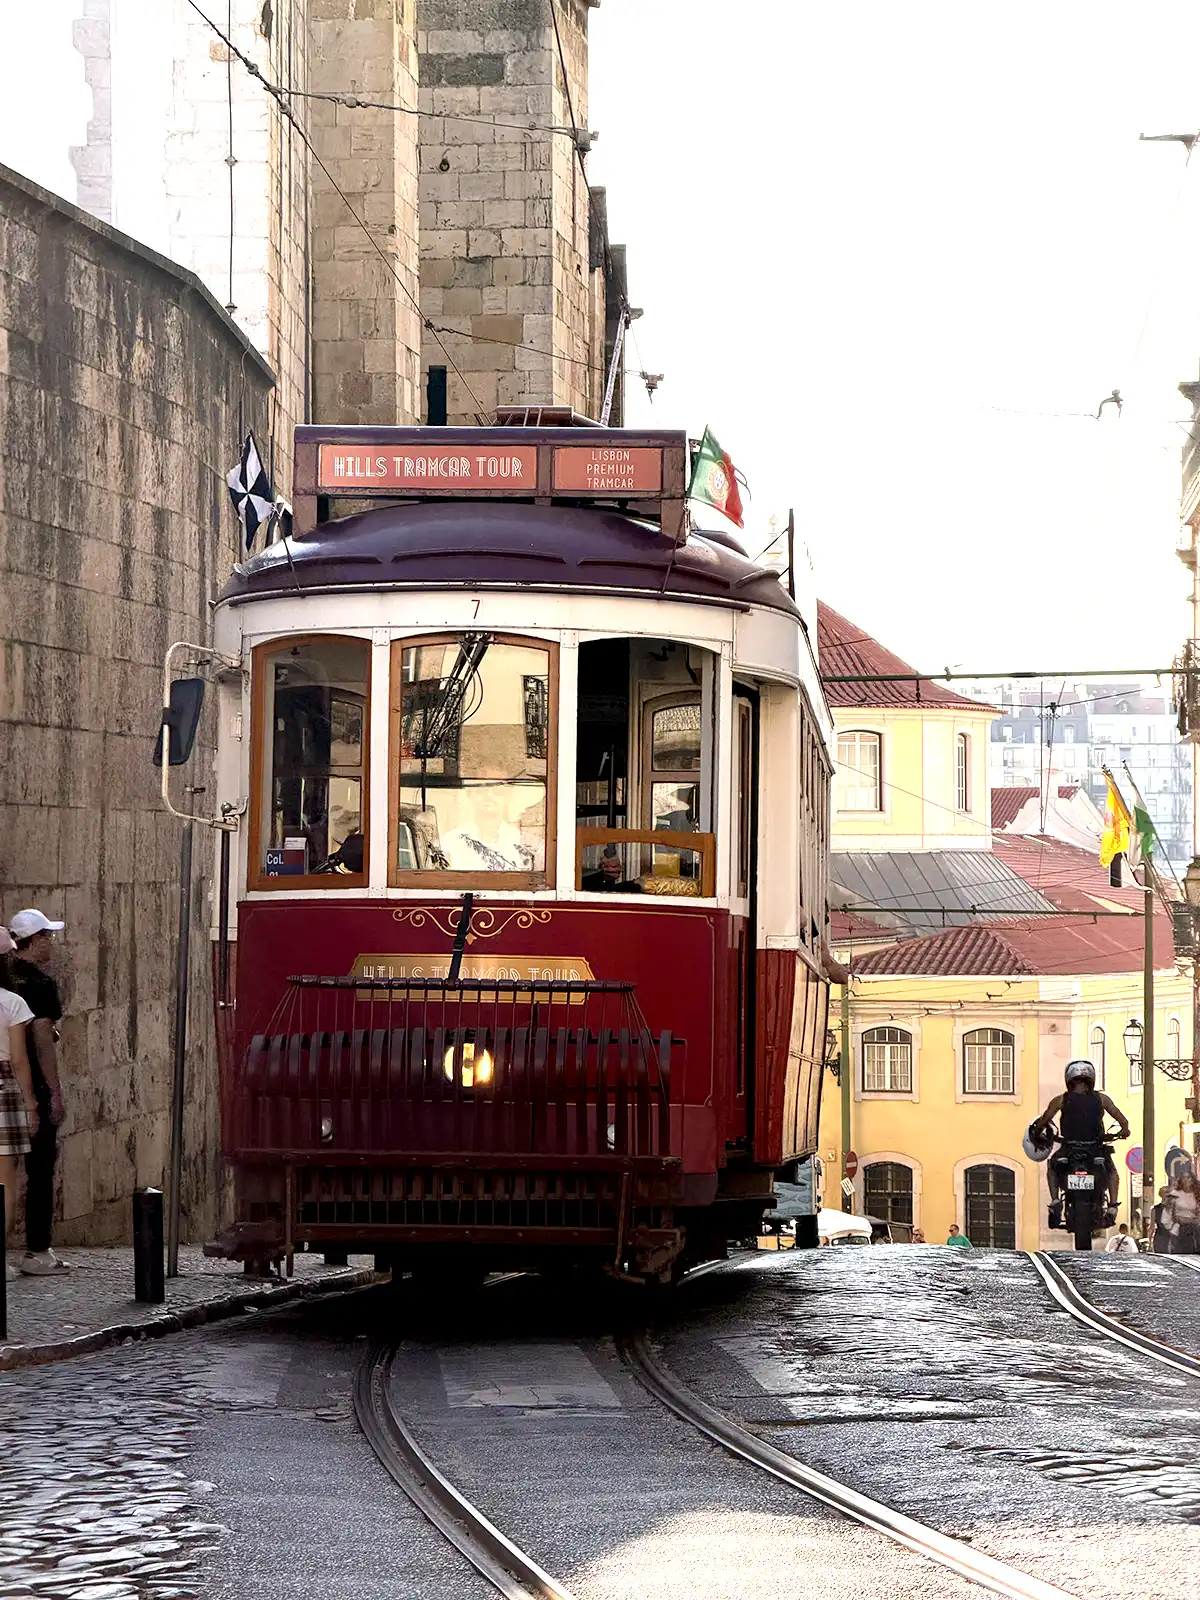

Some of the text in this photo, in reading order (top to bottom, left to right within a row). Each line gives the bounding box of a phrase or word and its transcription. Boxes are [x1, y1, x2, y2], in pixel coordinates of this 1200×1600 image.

[591, 450, 630, 461] LISBON
[334, 456, 523, 477] HILLS TRAMCAR TOUR
[586, 463, 634, 475] PREMIUM
[586, 477, 634, 488] TRAMCAR
[471, 599, 481, 619] 7
